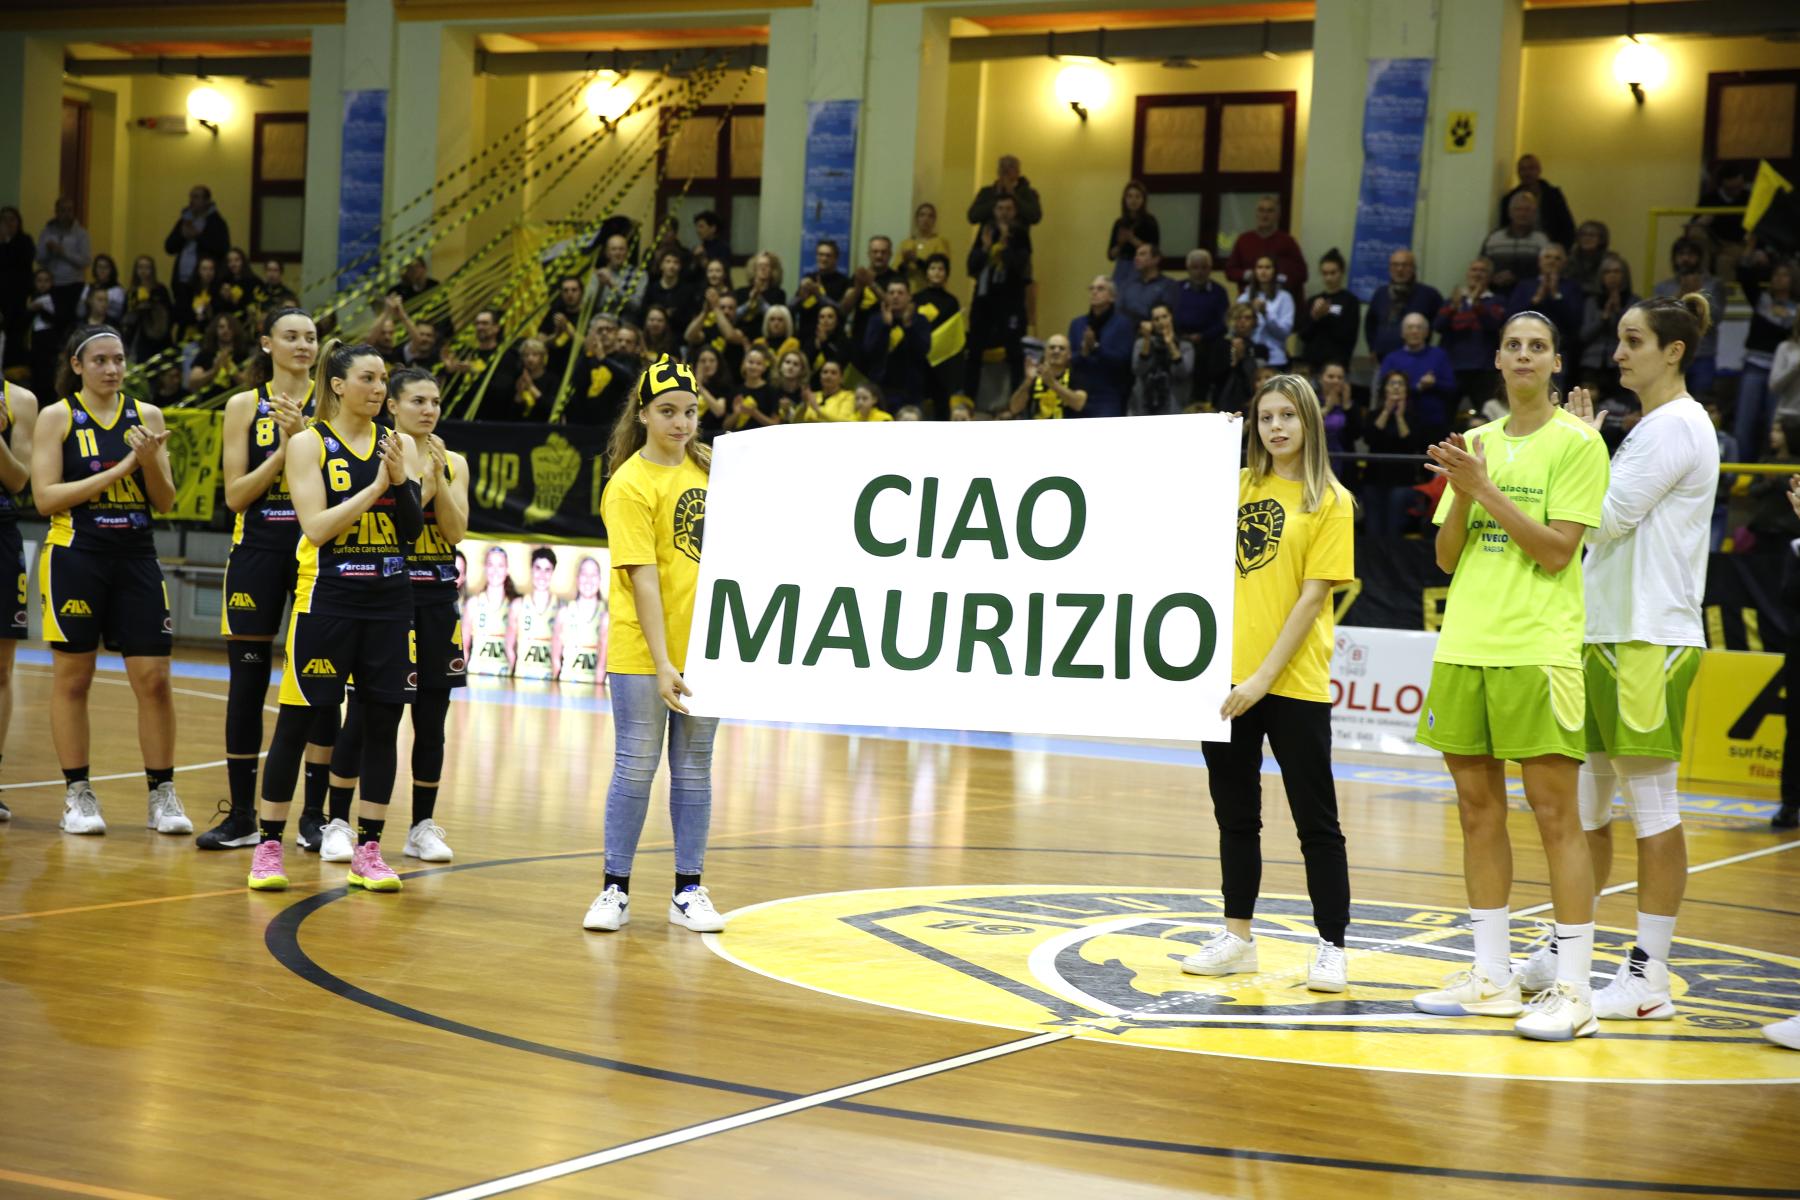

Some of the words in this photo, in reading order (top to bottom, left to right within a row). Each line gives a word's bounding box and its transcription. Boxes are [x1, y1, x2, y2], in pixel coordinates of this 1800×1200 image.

[76, 428, 99, 458] 11
[256, 417, 275, 446] 8
[327, 457, 352, 492] 6
[1497, 484, 1544, 495] alacqua
[854, 474, 1087, 561] CIAO
[415, 524, 452, 554] ILA
[60, 599, 93, 615] FILA
[705, 578, 1217, 682] MAURIZIO
[302, 658, 337, 674] FILA
